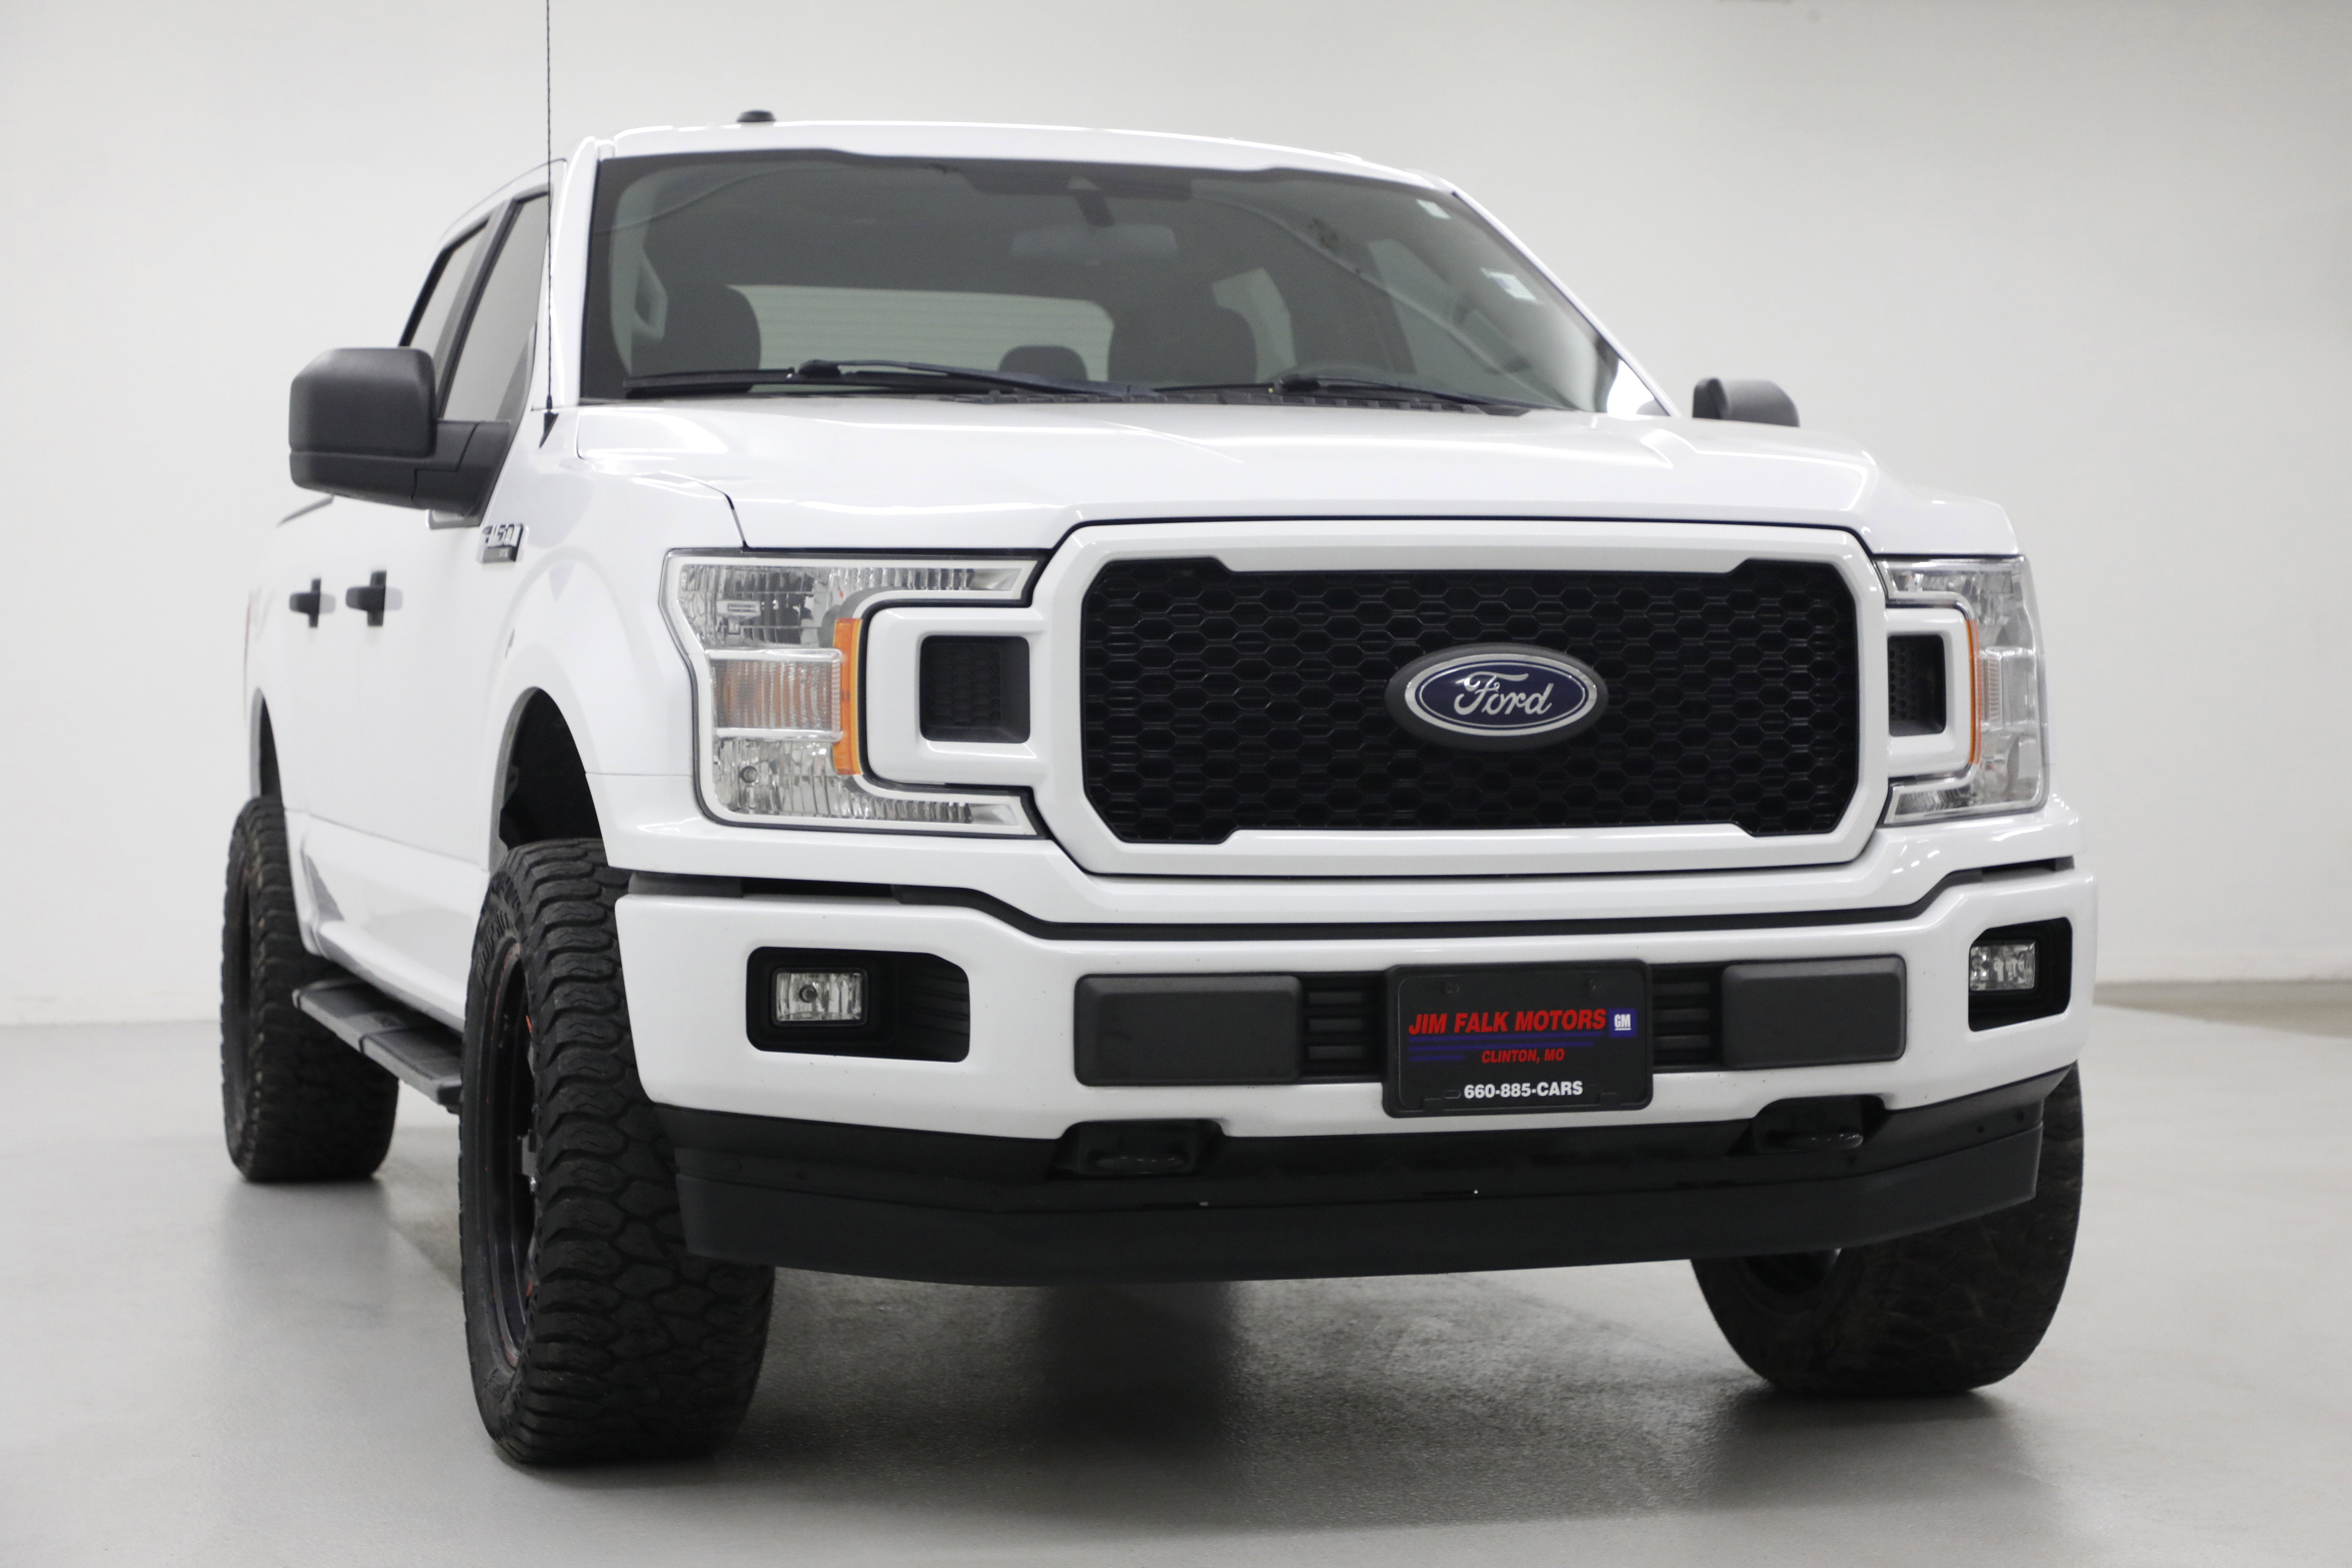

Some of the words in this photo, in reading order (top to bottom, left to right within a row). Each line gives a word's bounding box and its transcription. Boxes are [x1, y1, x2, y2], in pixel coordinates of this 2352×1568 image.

[1454, 670, 1555, 715] Ford
[1408, 1013, 1448, 1035] JIM
[1454, 1011, 1510, 1033] FALK
[1514, 1008, 1607, 1031] MOTORS
[1613, 1013, 1631, 1029] GM
[1481, 1049, 1541, 1064] CLINTON,
[1544, 1048, 1566, 1062] MO
[1463, 1080, 1584, 1099] 660-885-CARS
